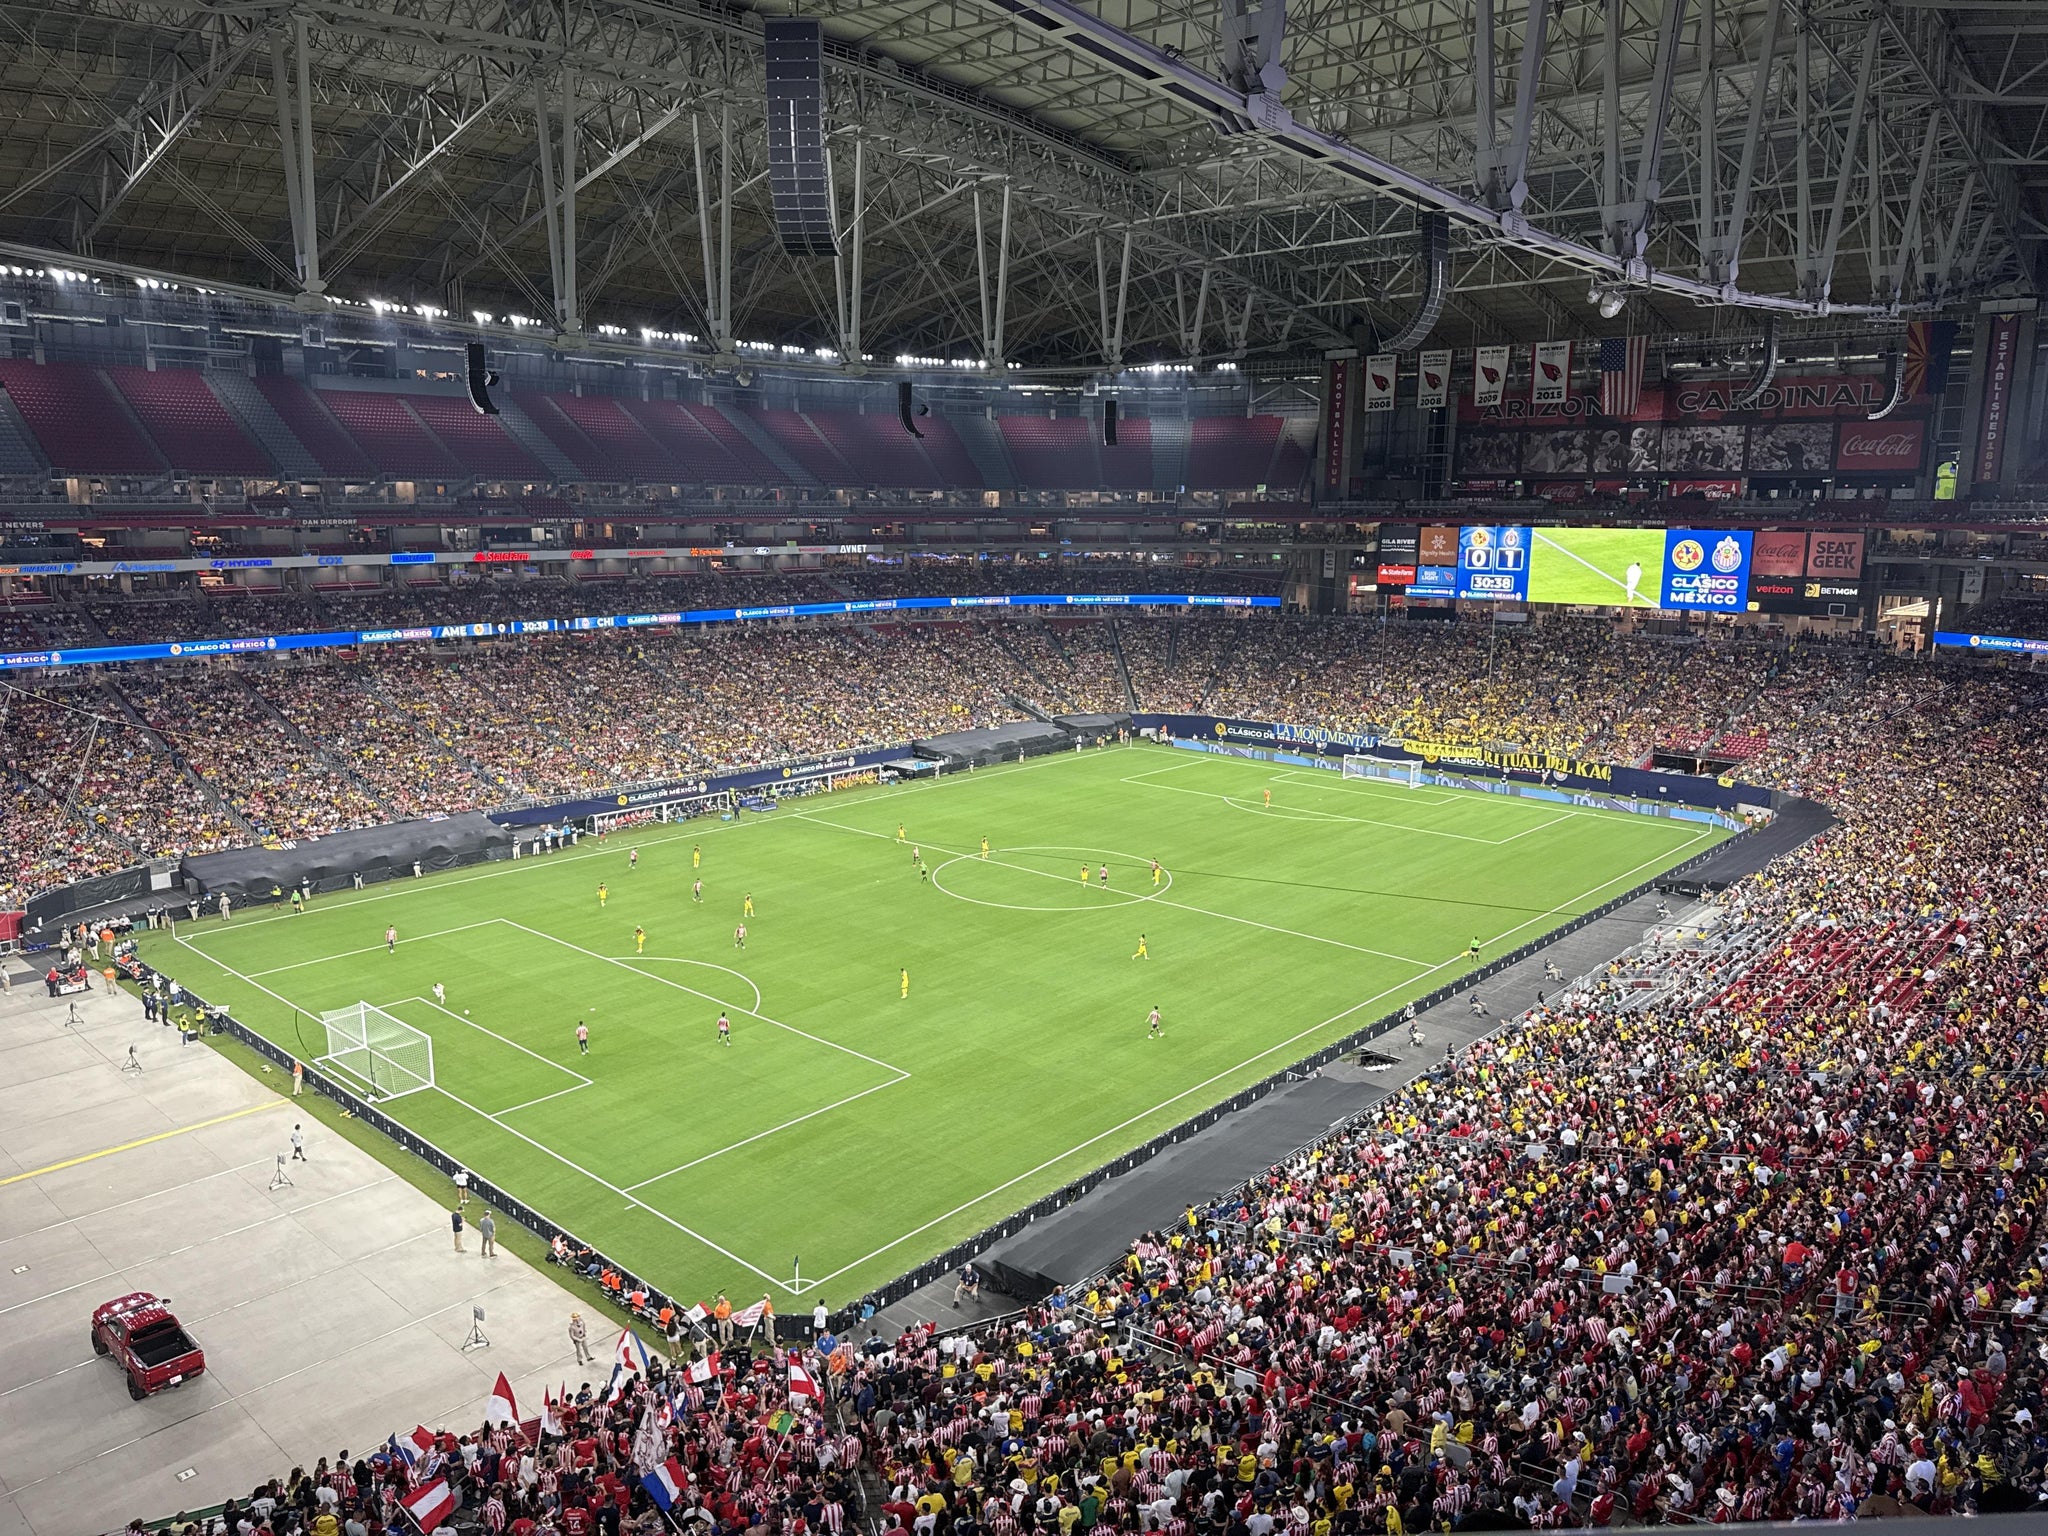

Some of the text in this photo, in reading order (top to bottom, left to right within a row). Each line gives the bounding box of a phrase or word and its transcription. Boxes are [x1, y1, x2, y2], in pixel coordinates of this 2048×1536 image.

[1477, 395, 1498, 404] 2009
[1536, 391, 1563, 400] 2015
[1676, 383, 1912, 413] CARDINAL
[1333, 373, 1343, 447] FOOTBALL
[1368, 401, 1391, 409] 2008
[1483, 396, 1602, 420] ARIZON
[1982, 331, 2009, 480] ESTABLISHED 1898
[1842, 434, 1918, 458] Coca-Cola
[1756, 543, 1801, 558] Coca-Cola
[1816, 541, 1857, 556] SEAT
[229, 559, 272, 567] HYUNDAI
[317, 556, 343, 565] COX
[1471, 550, 1487, 567] 0
[1505, 550, 1516, 567] 1
[1812, 555, 1856, 569] GEEK
[1474, 577, 1512, 589] 30:38
[1671, 577, 1739, 590] CLÁSICO
[1756, 584, 1794, 594] verizon
[1670, 590, 1737, 605] MÉXICO
[1821, 587, 1858, 596] BETMGM
[442, 626, 467, 637] AME
[498, 623, 506, 633] 0
[522, 621, 549, 631] 30:38
[597, 617, 614, 627] CHI
[2024, 641, 2048, 650] MÉXIC
[1227, 726, 1263, 738] CLÁSICO
[1264, 731, 1275, 740] DE
[1276, 723, 1291, 736] LA
[1294, 726, 1378, 748] MONUMENTAL
[1483, 750, 1543, 769] RITUAL
[1546, 755, 1573, 774] DEL
[256, 1506, 269, 1519] 17
